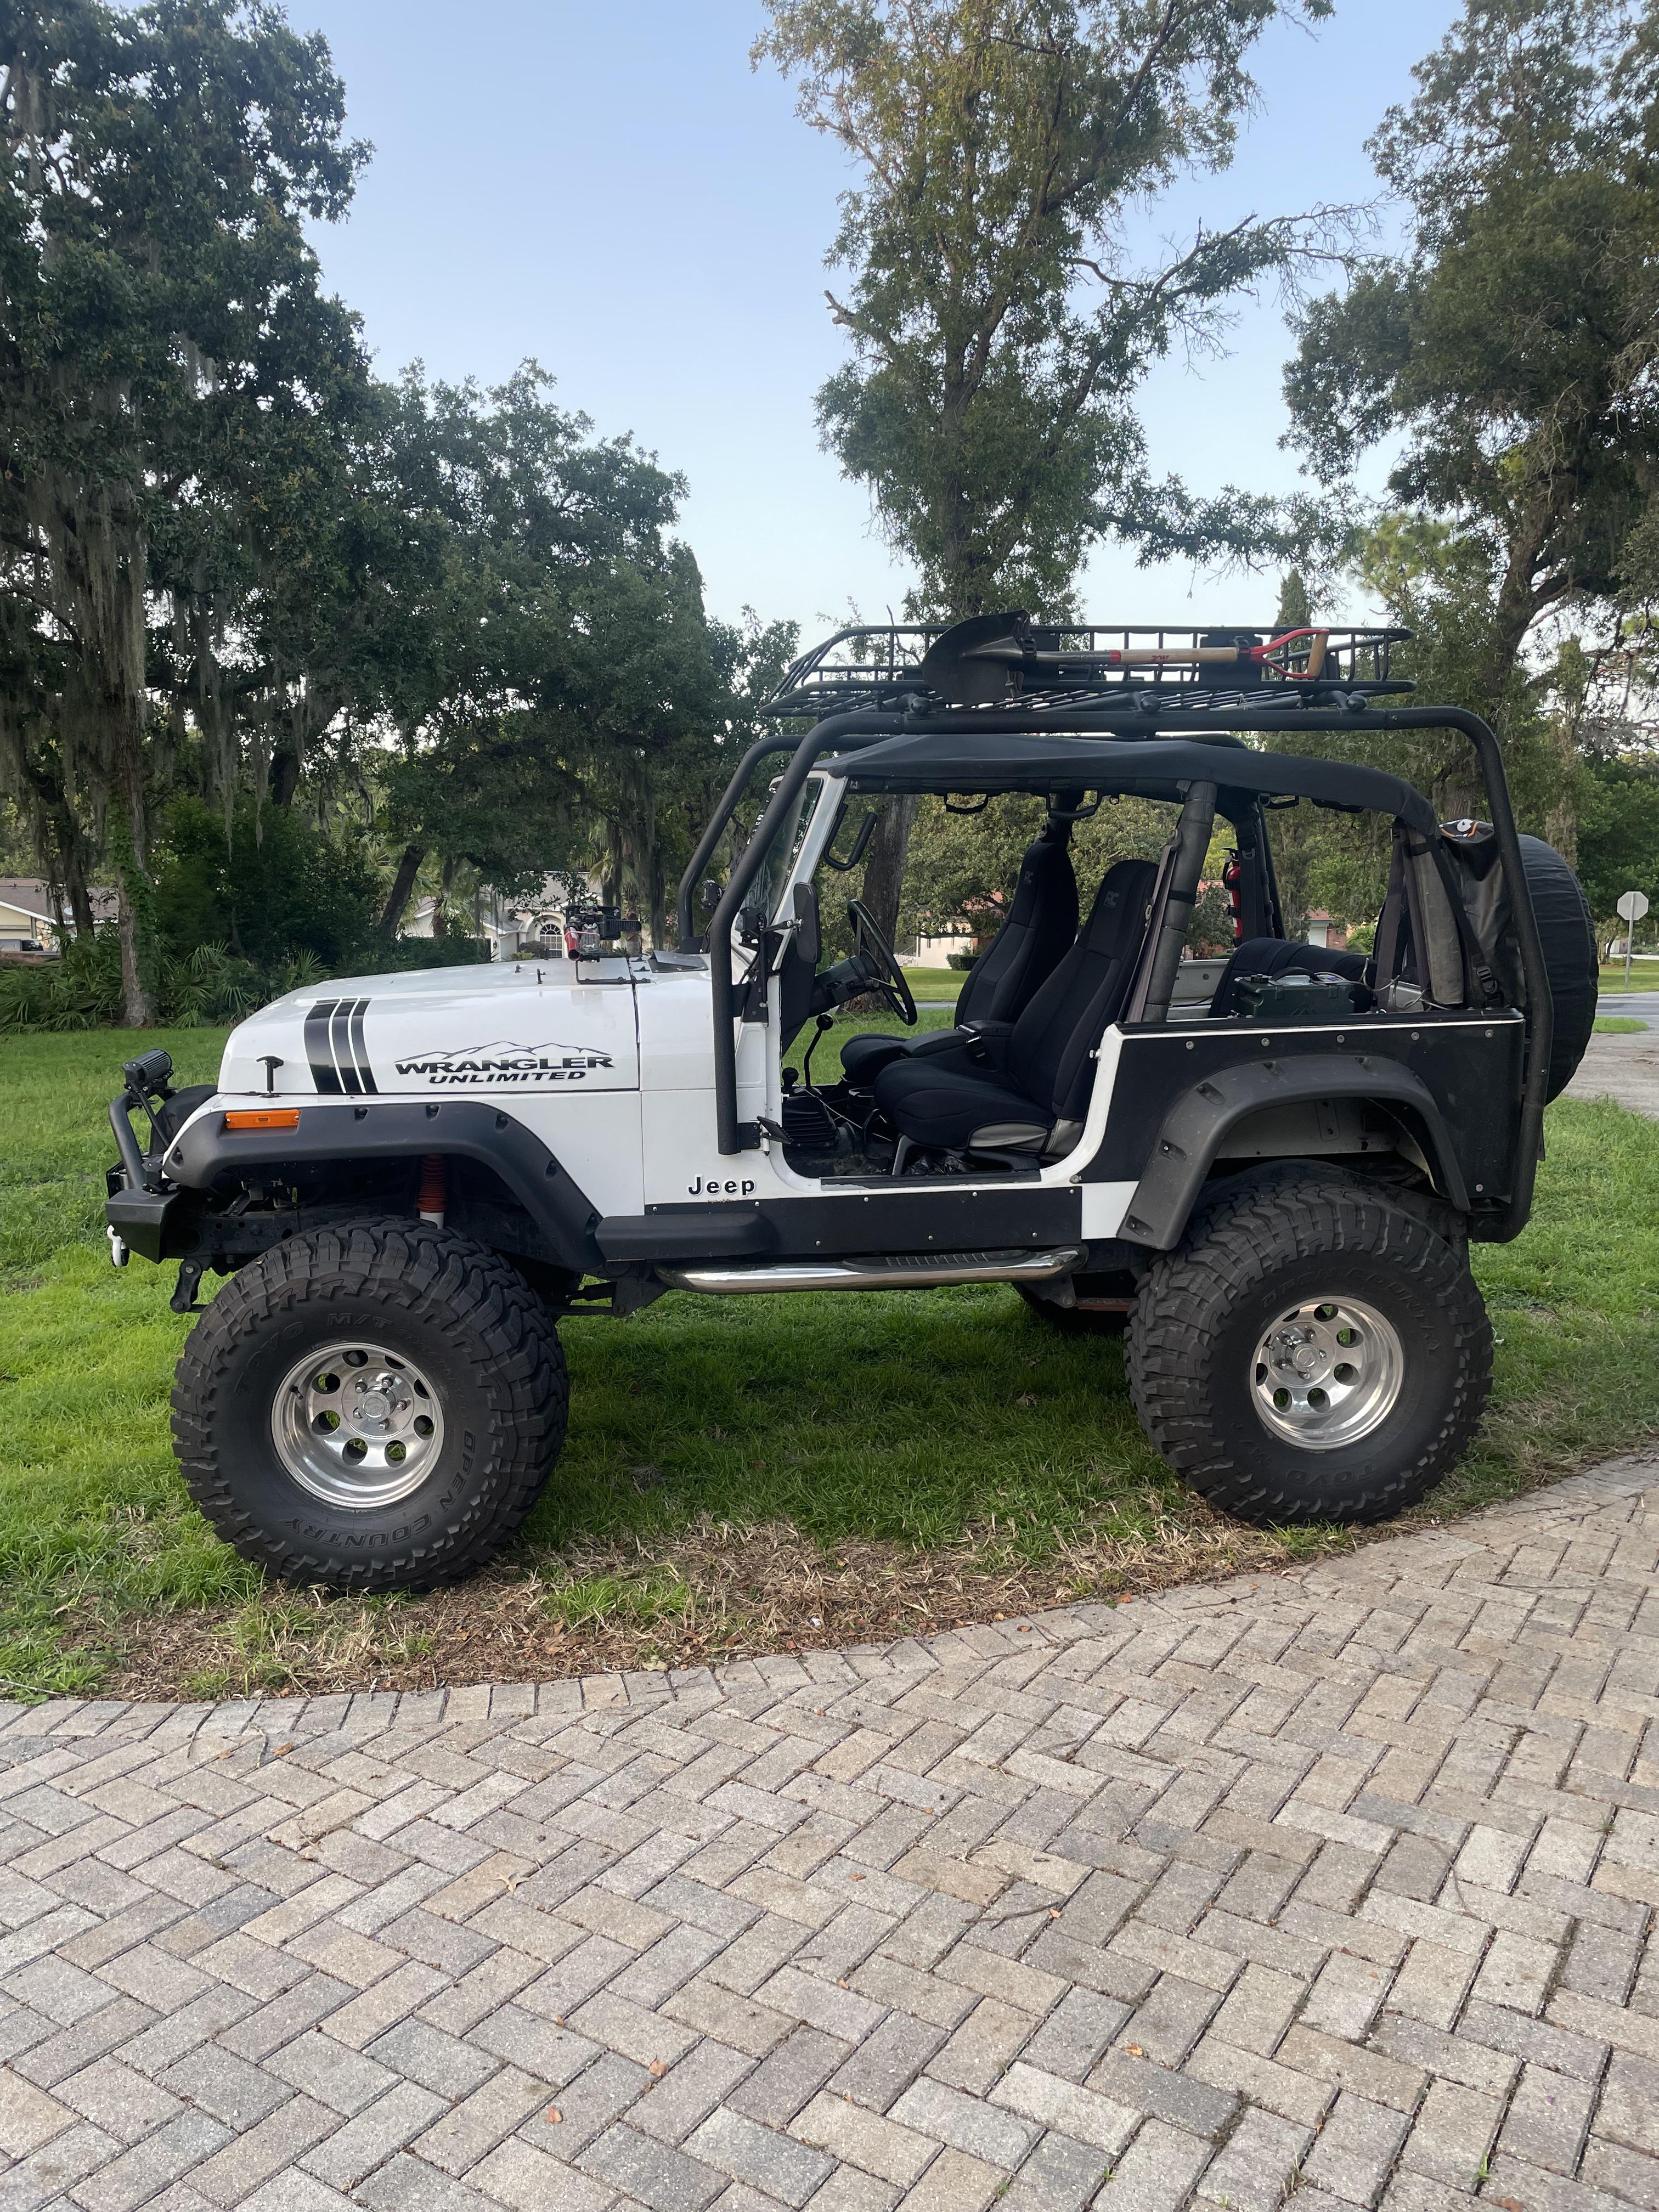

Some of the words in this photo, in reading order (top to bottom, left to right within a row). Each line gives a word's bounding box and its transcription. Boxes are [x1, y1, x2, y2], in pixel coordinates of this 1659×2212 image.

[394, 1057, 616, 1075] WRANGLER
[429, 1071, 586, 1084] UNLIMITED
[688, 1176, 755, 1195] Jeep
[1260, 1266, 1338, 1308] OPEN
[233, 1320, 306, 1397] TOYO
[326, 1312, 394, 1329] M/T
[437, 1429, 477, 1513] OPEN
[1285, 1463, 1379, 1487] TOYO
[278, 1512, 433, 1549] COUNTRY
